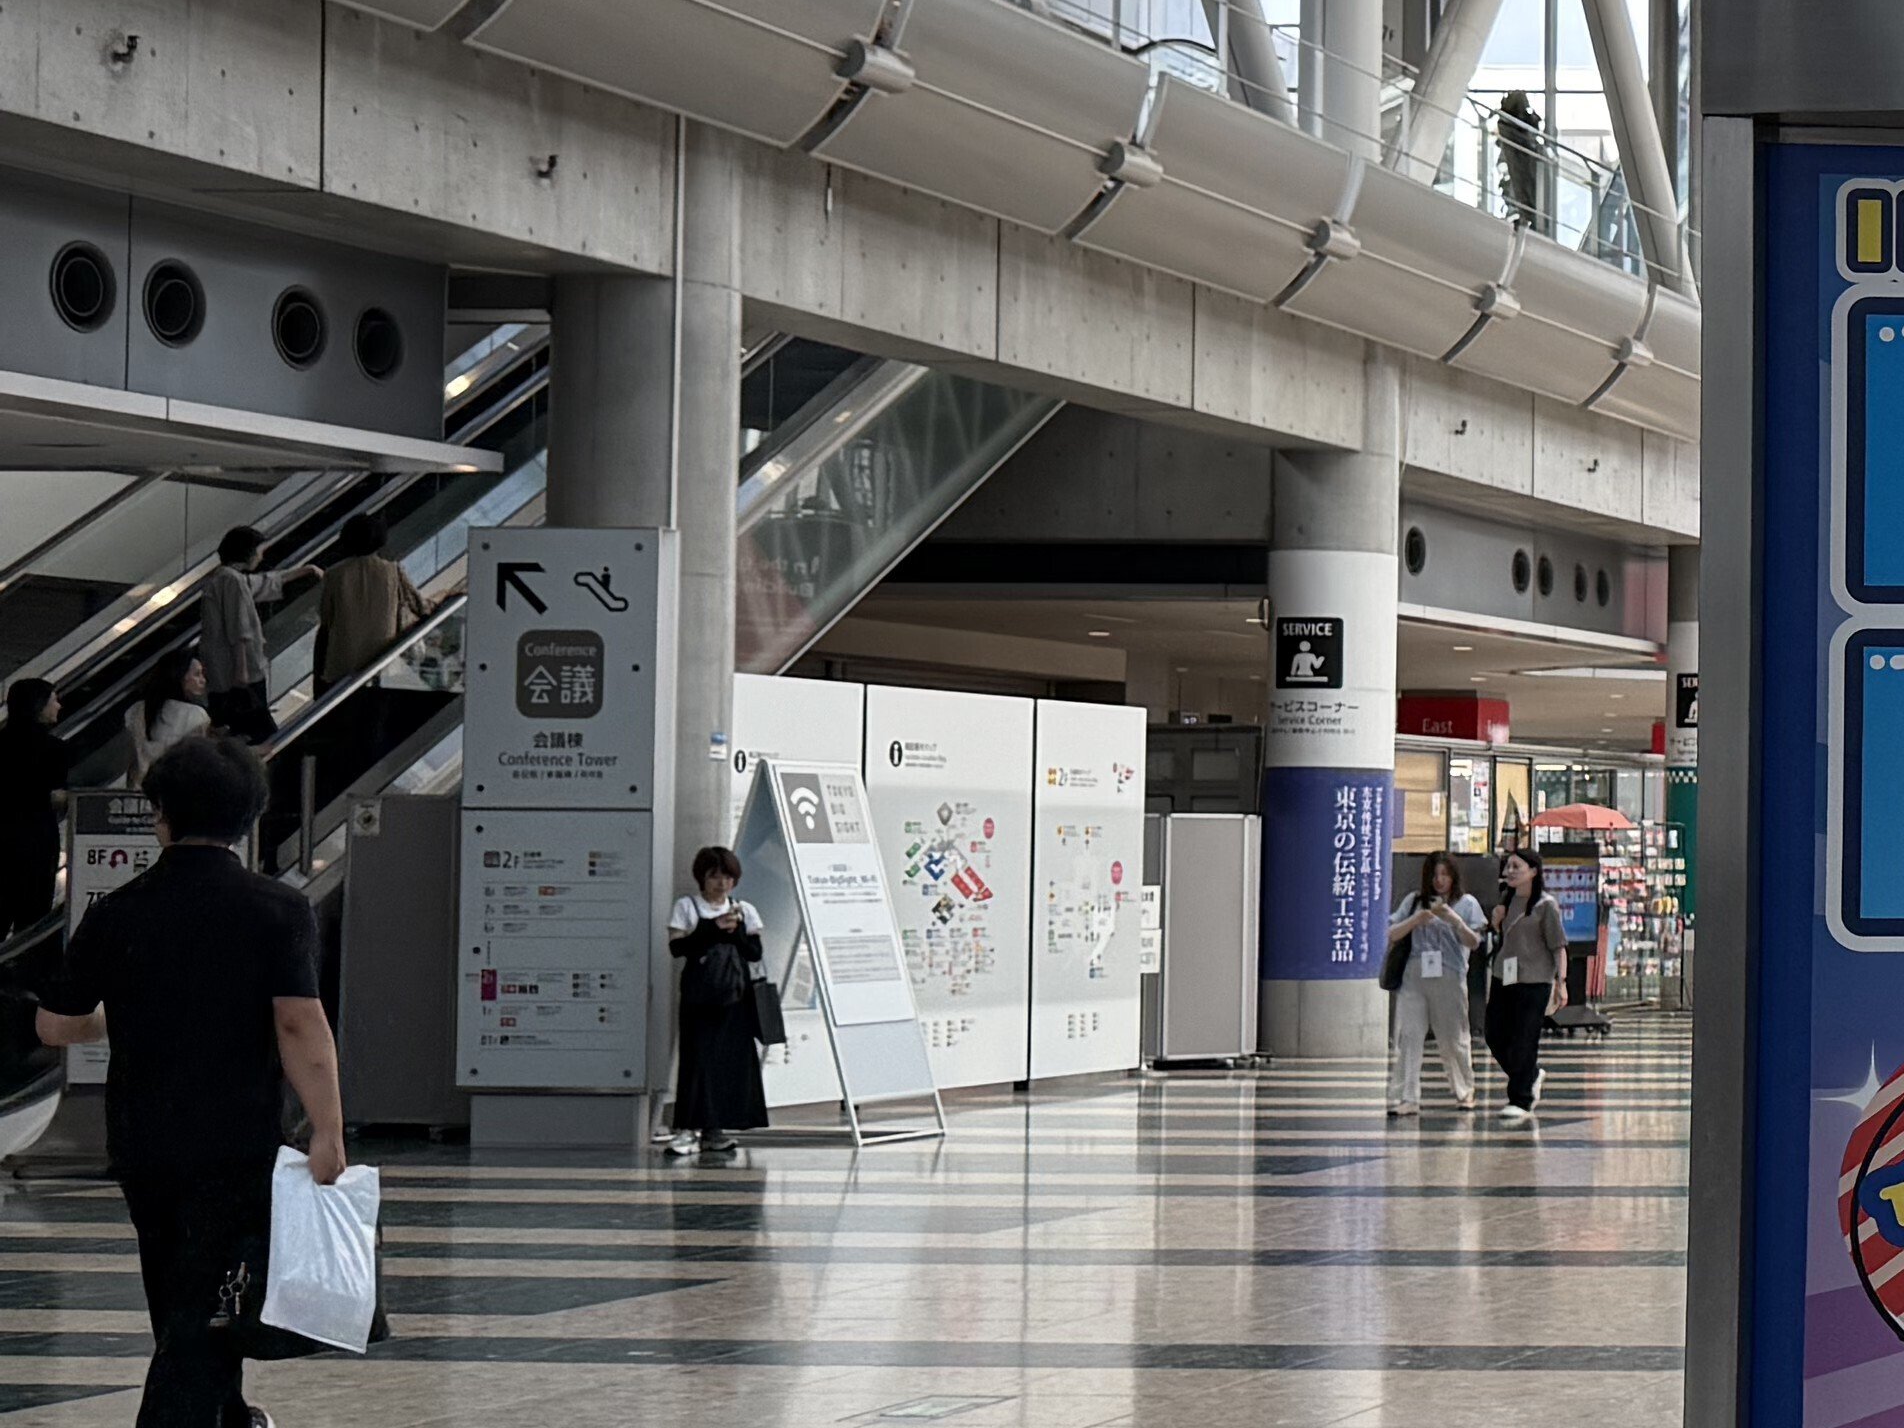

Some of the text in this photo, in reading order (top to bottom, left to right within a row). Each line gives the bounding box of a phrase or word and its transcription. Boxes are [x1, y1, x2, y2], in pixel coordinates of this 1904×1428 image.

[1282, 623, 1333, 637] SERVICE
[525, 643, 597, 657] Conference
[524, 665, 596, 705] 会議
[1421, 719, 1454, 735] East
[498, 752, 618, 767] Conference Tower
[1332, 785, 1356, 963] 東京の伝統工芸品
